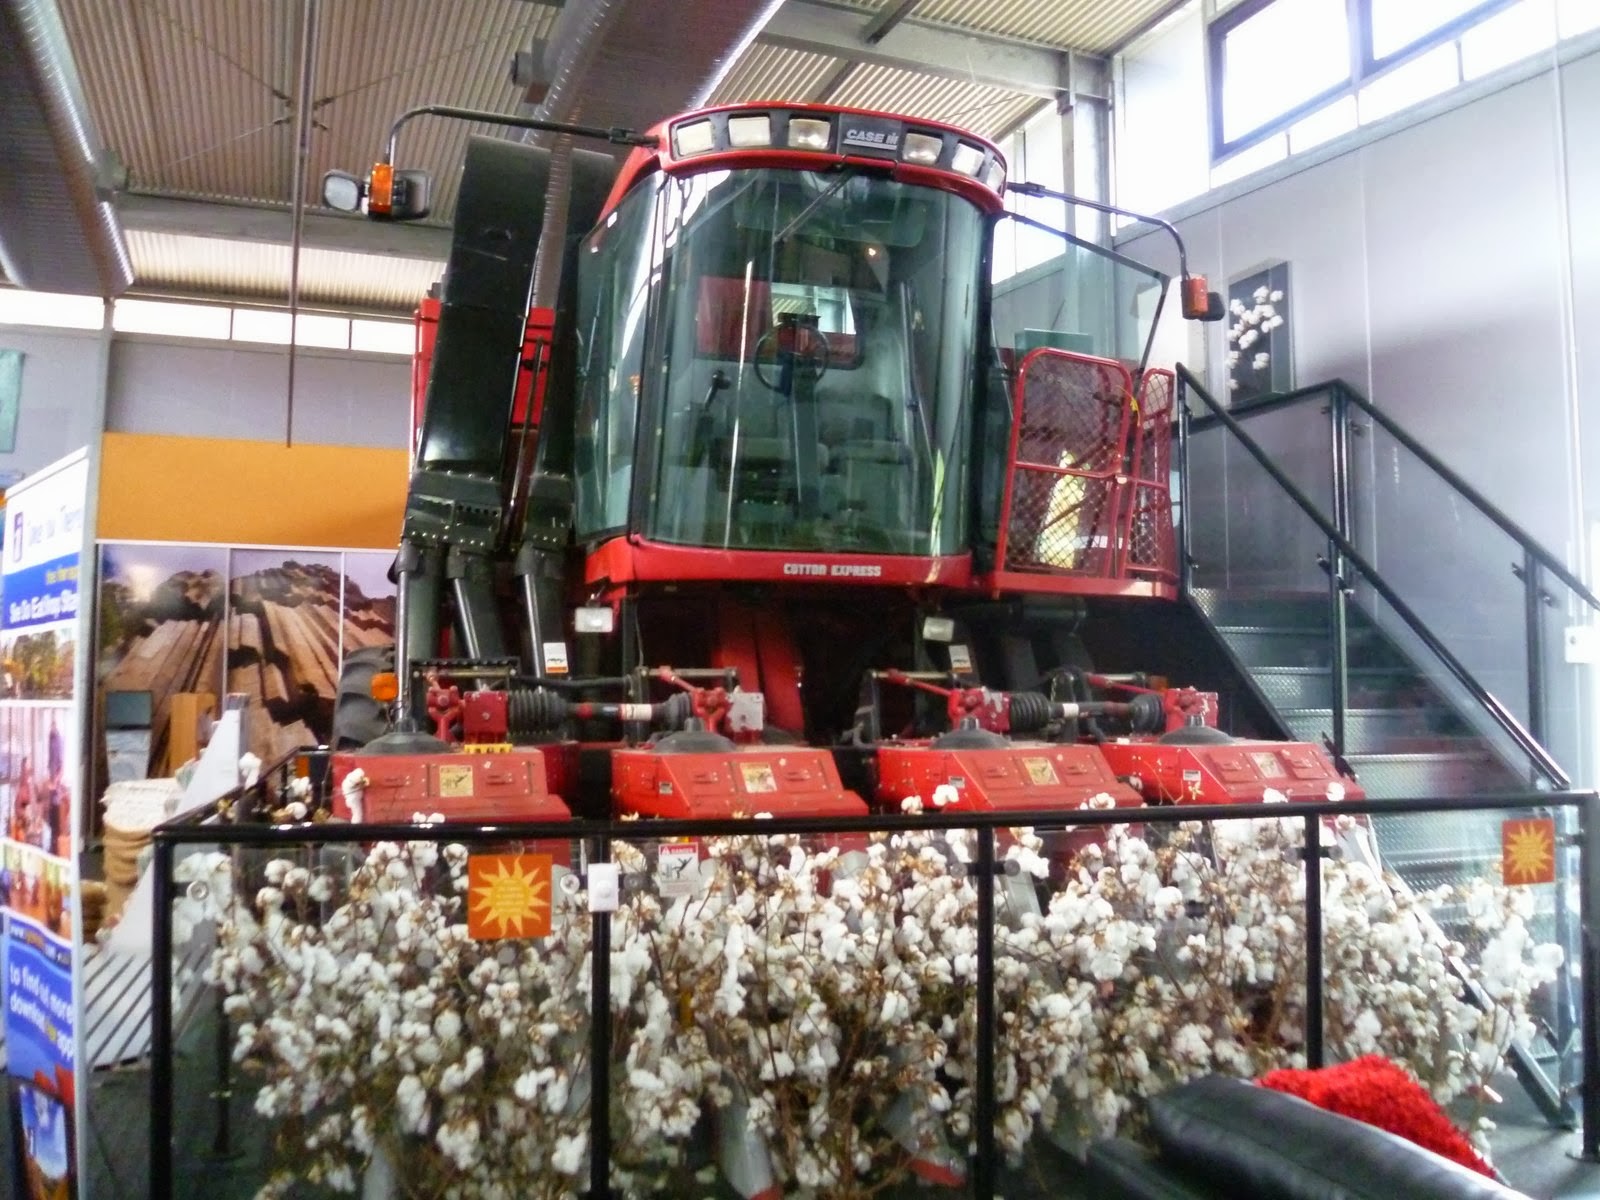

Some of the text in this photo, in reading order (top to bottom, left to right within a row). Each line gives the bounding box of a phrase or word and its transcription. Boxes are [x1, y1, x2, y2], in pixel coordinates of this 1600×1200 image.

[846, 129, 885, 143] CASE
[784, 563, 881, 576] COTTON EXPRESS
[10, 962, 20, 986] to
